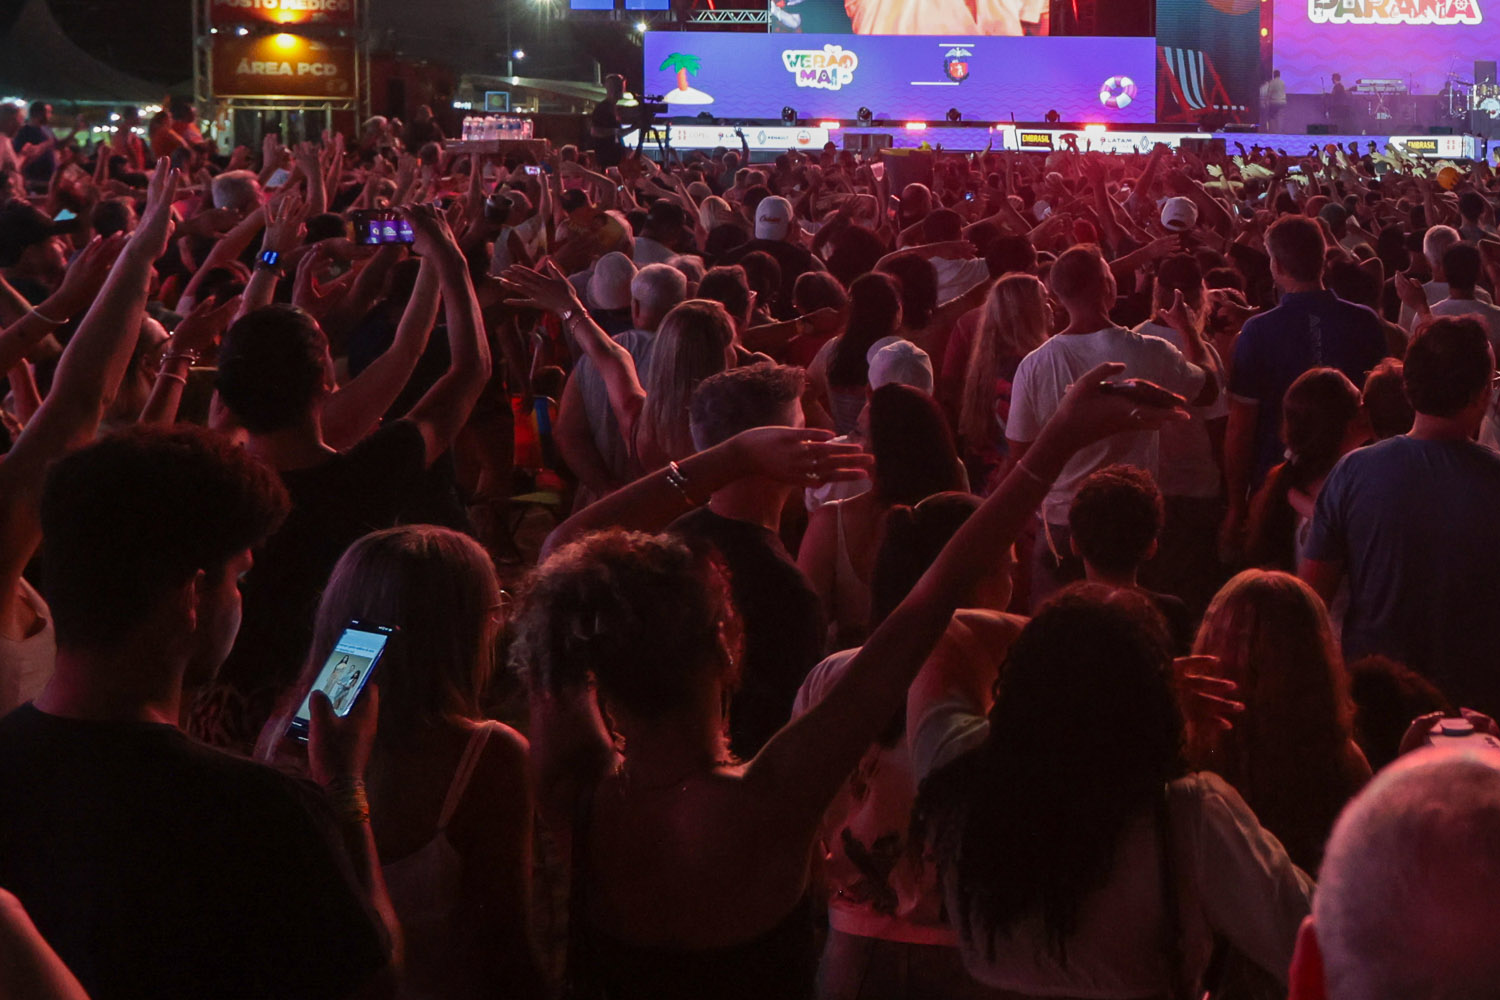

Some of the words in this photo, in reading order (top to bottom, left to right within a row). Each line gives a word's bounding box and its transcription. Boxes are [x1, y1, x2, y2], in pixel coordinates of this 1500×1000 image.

[236, 57, 293, 76] ÁREA
[297, 62, 337, 76] PCD
[1022, 134, 1050, 143] EMBRASIL
